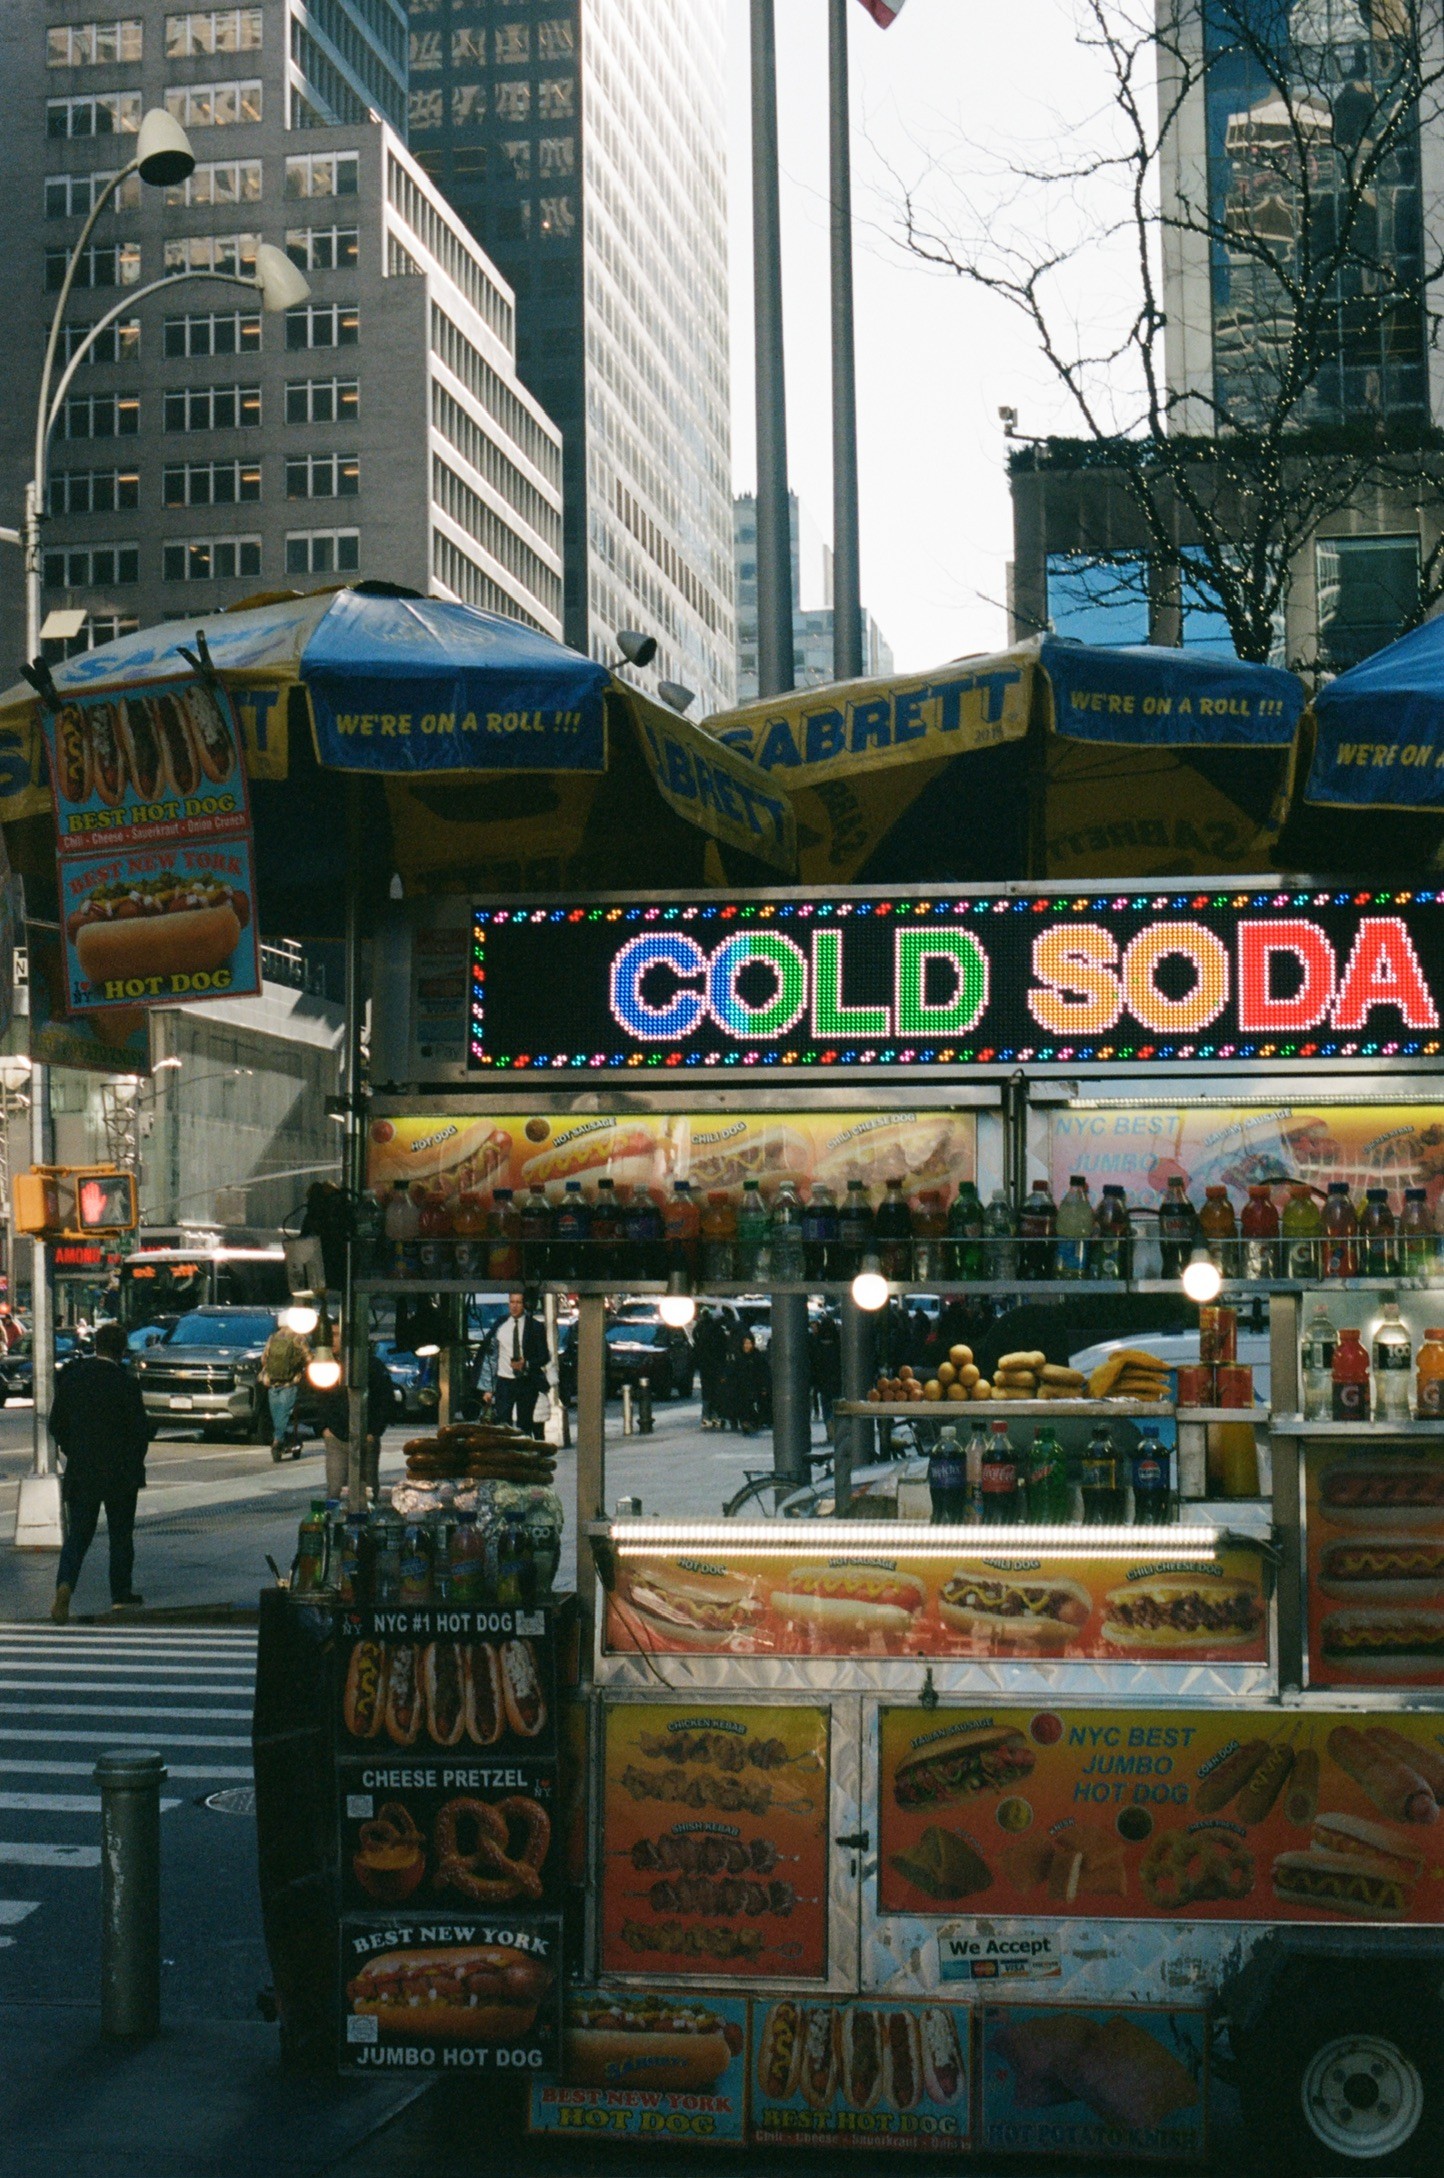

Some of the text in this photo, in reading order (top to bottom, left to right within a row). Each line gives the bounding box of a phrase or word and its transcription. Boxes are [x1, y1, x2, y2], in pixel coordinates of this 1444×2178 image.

[1069, 690, 1285, 717] WE'RE ON A ROLL !!!
[336, 711, 582, 737] WE'RE ON A ROLL !!!
[1337, 742, 1398, 767] WE'RE
[1400, 744, 1434, 767] ON
[67, 793, 236, 833] BEST HOT DOG
[63, 814, 246, 849] Chili Cheese Sauerkraut Onion Crunch
[69, 850, 244, 895] BEST NEW YORK
[105, 976, 162, 1002] HOT
[167, 968, 233, 994] DOG
[609, 916, 1441, 1042] COLD SODA
[552, 1117, 617, 1148] HOT SAUSAGE
[691, 1120, 747, 1146] CHILI DOG
[826, 1113, 916, 1150] CHILI CHEESE DOG
[1056, 1115, 1180, 1135] NYC BEST
[411, 1125, 458, 1152] HOT DOG
[1068, 1152, 1160, 1172] JUMBO
[1341, 1384, 1360, 1408] G
[1423, 1383, 1440, 1406] G
[677, 1556, 726, 1575] HOT DOG
[829, 1557, 896, 1571] HOT SAUSAGE
[1013, 1560, 1040, 1571] DOG
[1126, 1562, 1223, 1580] CHILI CHEESE DOG
[374, 1613, 513, 1633] NYC #1 HOT DOG
[668, 1717, 748, 1735] CHICKEN KEBAB
[910, 1717, 994, 1750] ITALIAN SAUSAGE
[1069, 1726, 1197, 1747] NYC BEST
[1218, 1740, 1240, 1762] DOG
[1082, 1754, 1174, 1776] JUMBO
[362, 1769, 528, 1789] CHEESE PRETZEL
[1073, 1782, 1191, 1805] HOT DOG
[672, 1821, 741, 1837] SHISH KEBAB
[352, 1925, 550, 1955] BEST NEW YORK
[949, 1937, 1052, 1956] We Accept
[356, 2046, 544, 2068] JUMBO HOT DOG
[542, 2086, 733, 2113] BEST NEW YORK
[559, 2106, 716, 2135] HOT DOG
[763, 2107, 958, 2135] BEST HOT DOG
